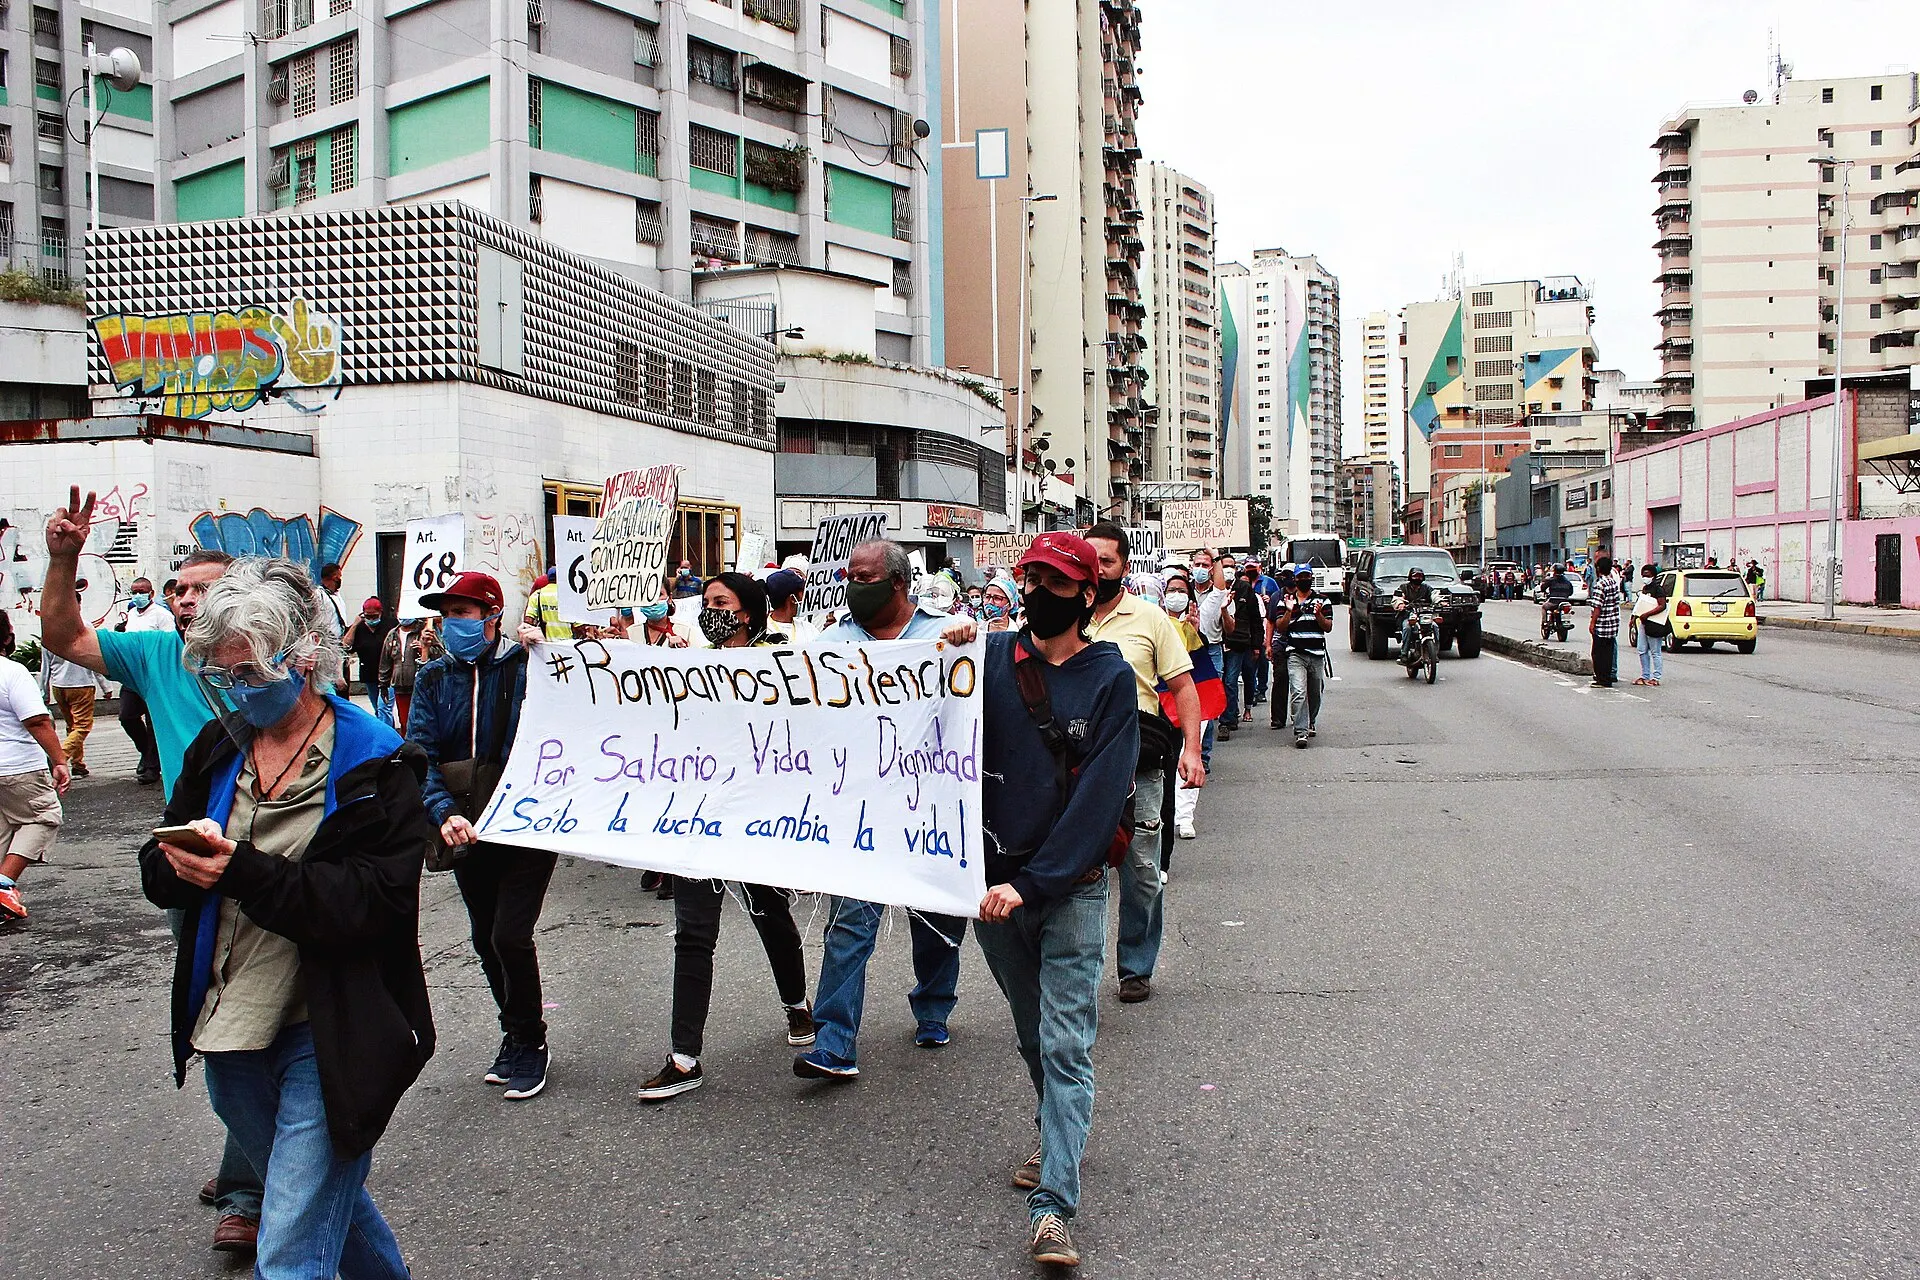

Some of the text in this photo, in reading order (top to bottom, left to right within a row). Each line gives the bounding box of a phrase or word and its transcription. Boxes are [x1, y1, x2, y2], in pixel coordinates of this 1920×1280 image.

[1164, 508, 1238, 520] AUMENTOS DE
[1214, 501, 1234, 510] TUS
[566, 529, 586, 543] Art.
[1164, 517, 1234, 529] SALARIOS SON
[1165, 529, 1186, 540] UNA
[416, 530, 437, 544] Art.
[1128, 530, 1154, 556] ARIO
[590, 540, 664, 574] CONTRATO
[413, 551, 456, 591] 68
[568, 554, 589, 595] 6
[805, 569, 833, 588] ACU
[587, 571, 659, 606] COLECTIVO
[545, 638, 977, 731] #RompamosElSilencio
[533, 714, 979, 812] Por Salario, Vida y Dignidad
[479, 782, 968, 869] ¡Sólo la lucha cambia la vida!
